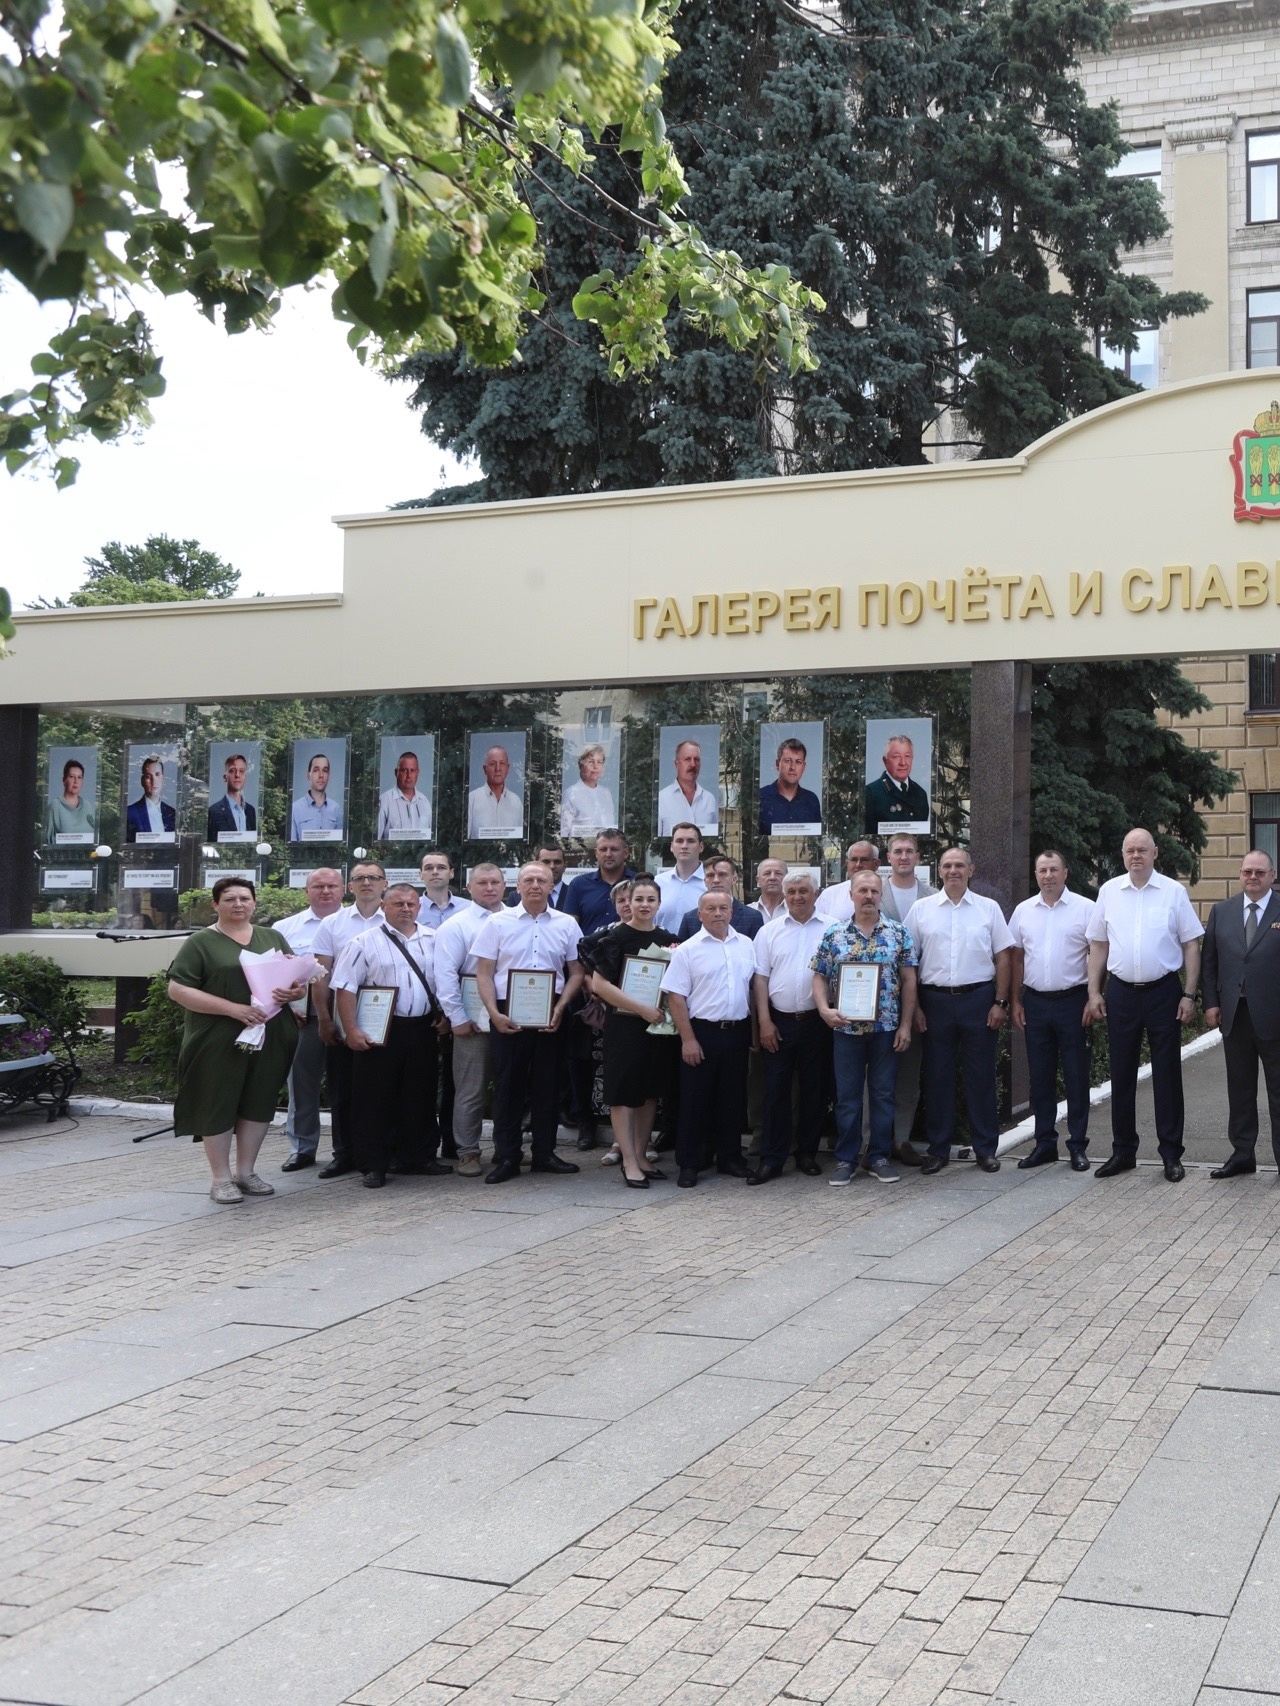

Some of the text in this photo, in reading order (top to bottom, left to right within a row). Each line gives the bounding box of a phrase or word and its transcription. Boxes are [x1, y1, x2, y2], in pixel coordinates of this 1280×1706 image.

[633, 586, 841, 639] ГАЛЕРЕЯ
[858, 566, 1054, 627] ПОЧЁТА
[1069, 570, 1103, 615] И
